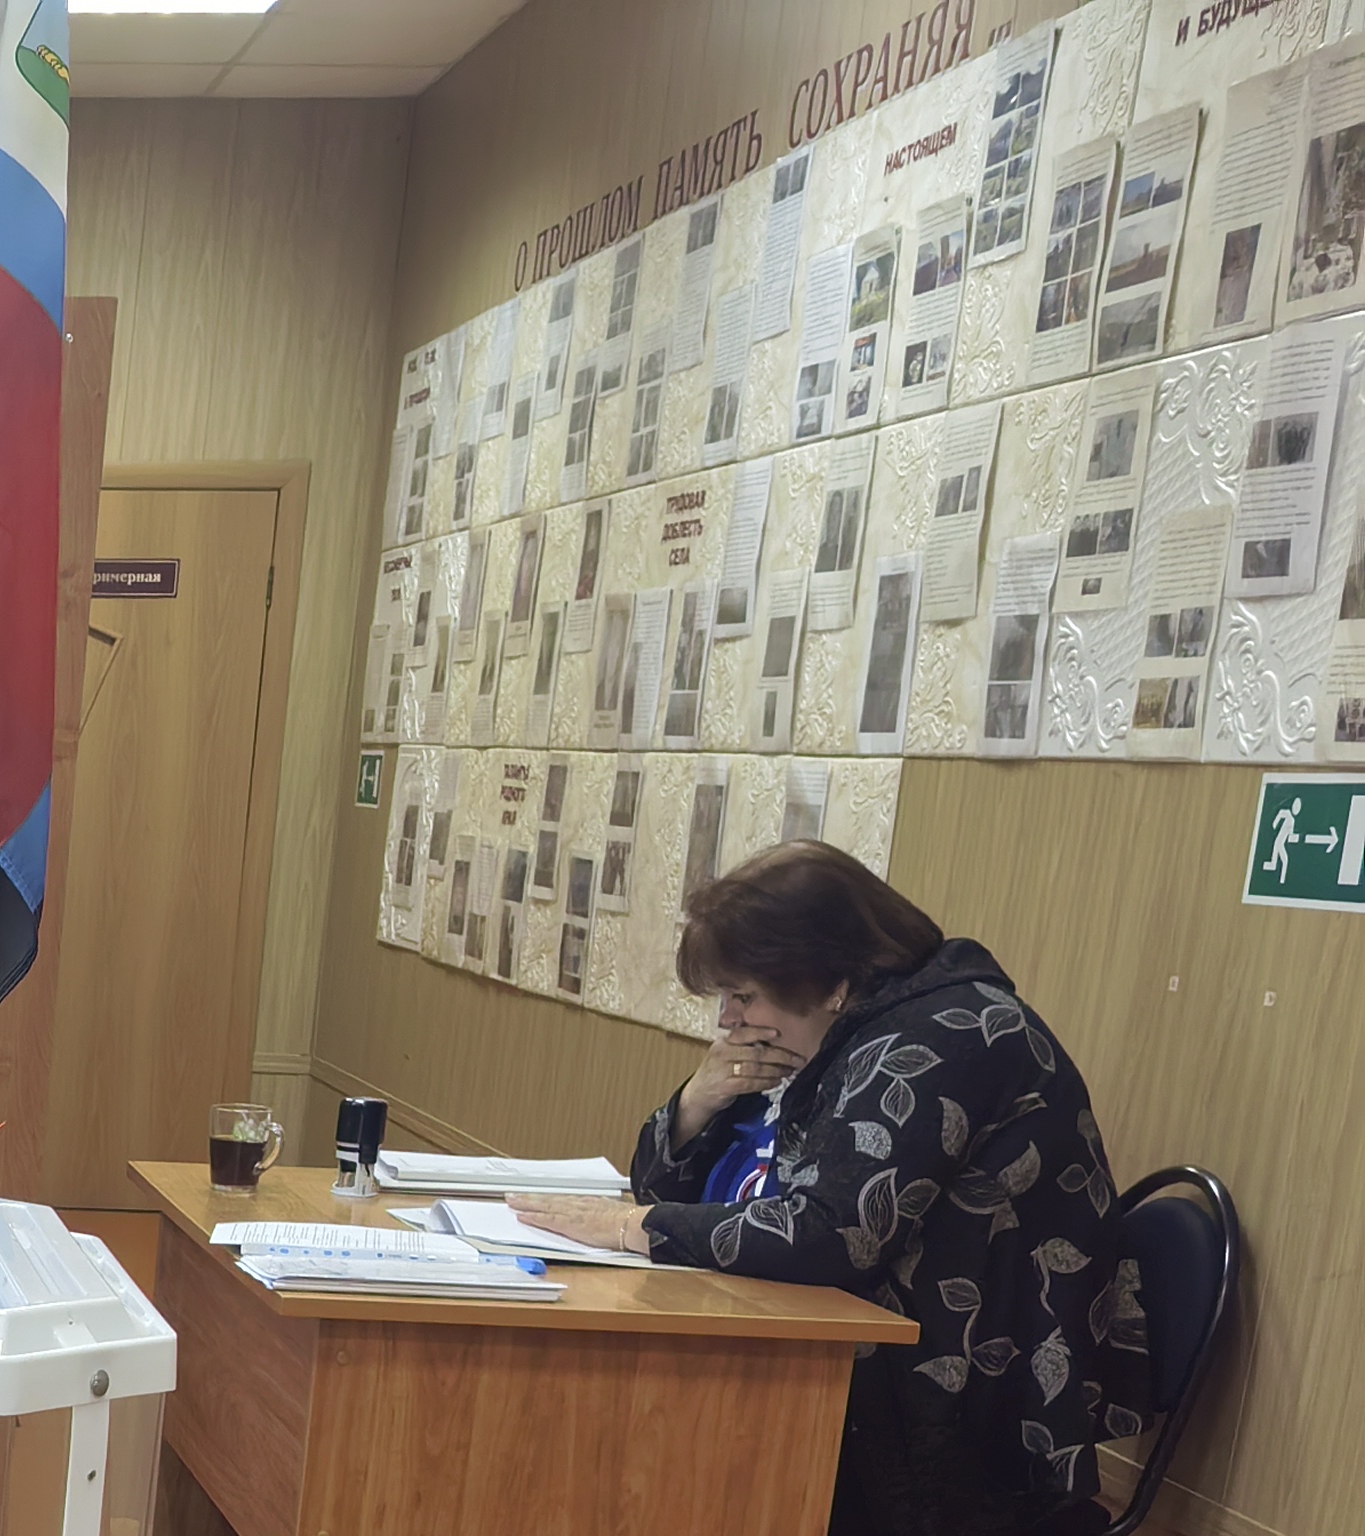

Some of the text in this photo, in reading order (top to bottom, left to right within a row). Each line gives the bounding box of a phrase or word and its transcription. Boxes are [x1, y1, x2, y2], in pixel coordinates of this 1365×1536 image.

[1174, 15, 1191, 46] И
[514, 0, 975, 292] О ПРОШЛОМ ПАМЯТЬ СОХРАНЯЯ
[883, 121, 958, 177] НАСТОЯЩЕМ
[93, 572, 162, 585] римерная
